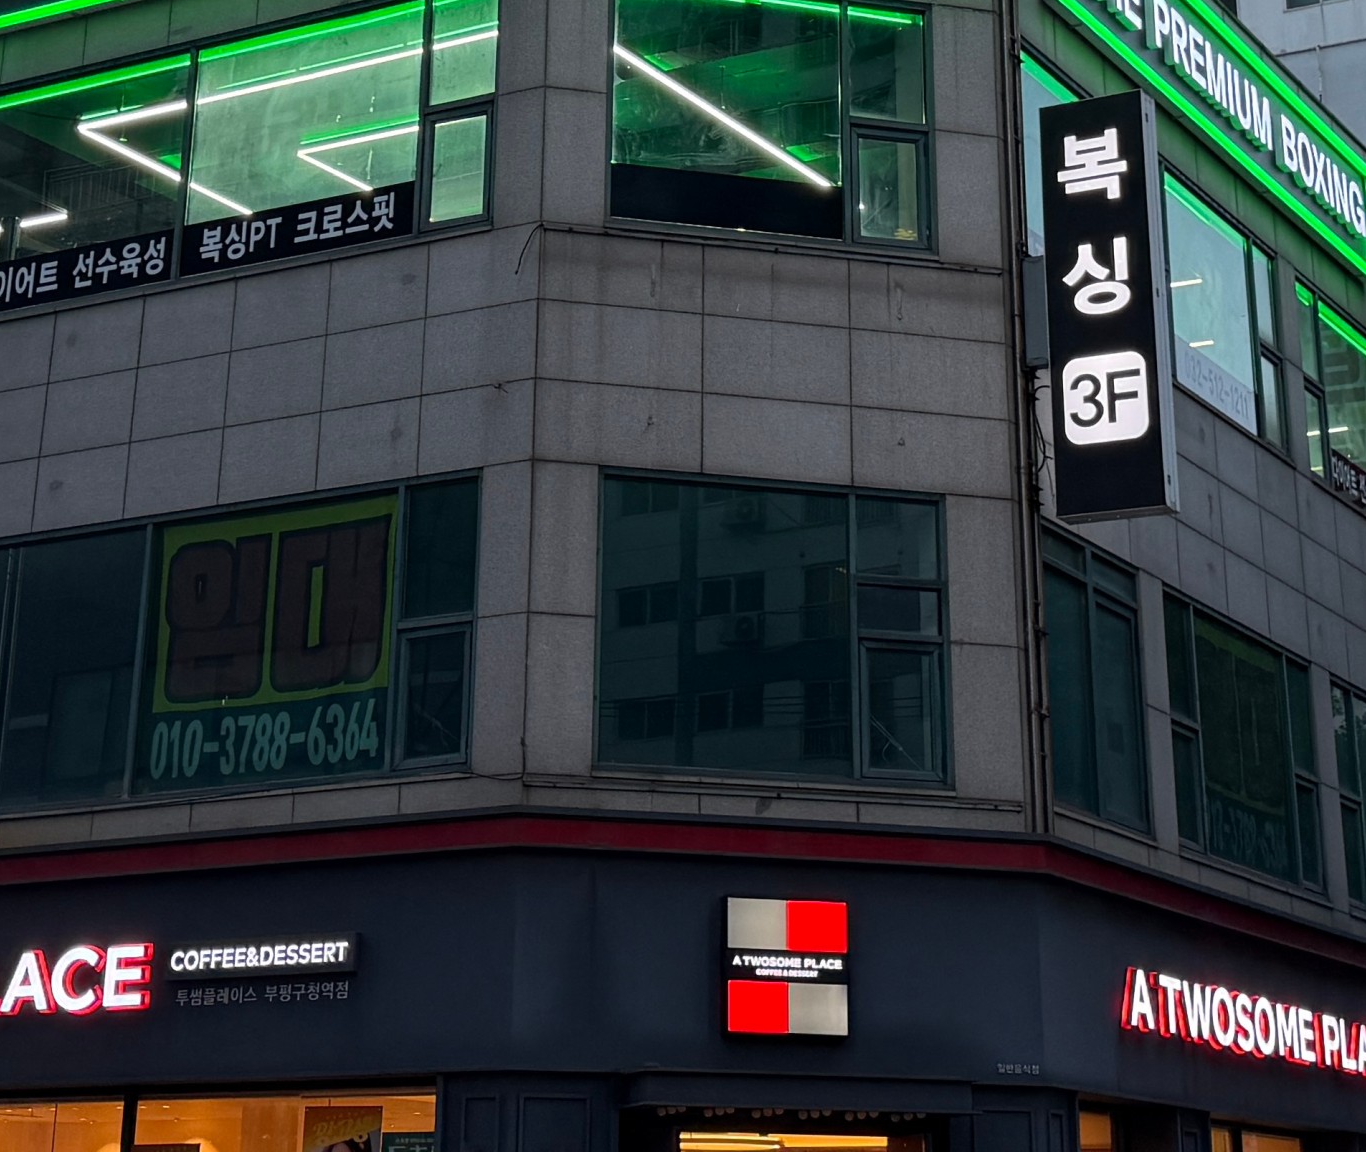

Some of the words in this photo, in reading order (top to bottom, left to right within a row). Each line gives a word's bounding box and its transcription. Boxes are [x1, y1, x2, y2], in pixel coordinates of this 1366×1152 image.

[72, 236, 167, 289] 선수육성
[199, 216, 283, 264] 복싱PT
[294, 191, 396, 244] 크로스핏
[1057, 127, 1132, 316] 복싱
[1069, 367, 1141, 428] 3F
[164, 513, 393, 704] 임대
[150, 698, 379, 780] 010-3788-6364
[170, 941, 349, 972] COFFEE&DESSERT
[175, 987, 258, 1007] 투썸플레이스
[264, 979, 350, 1002] 부평구청역점
[732, 955, 742, 966] A
[742, 956, 802, 969] TWOSOME
[804, 958, 843, 970] PLACE
[1159, 974, 1316, 1064] TWOSOME
